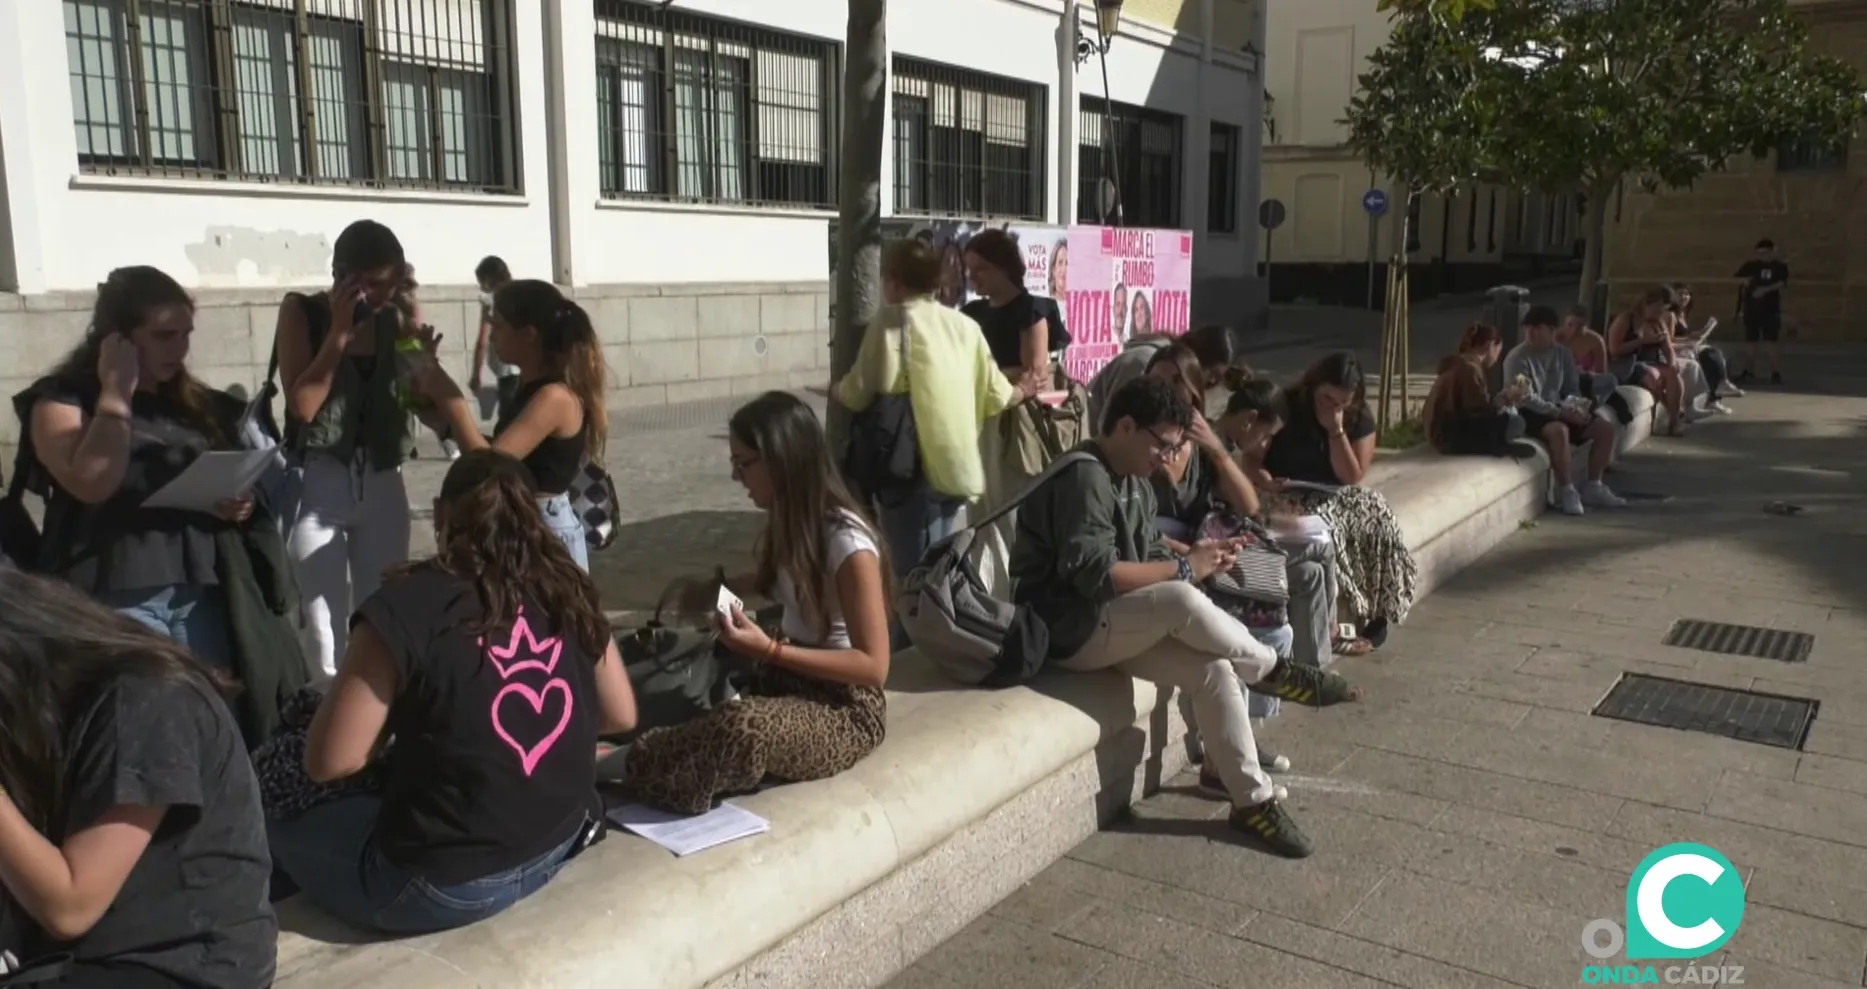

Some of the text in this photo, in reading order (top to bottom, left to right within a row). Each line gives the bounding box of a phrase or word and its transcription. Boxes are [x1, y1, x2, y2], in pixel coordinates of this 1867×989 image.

[1028, 244, 1046, 256] VOTA
[1112, 227, 1154, 259] MARCA EL
[1028, 255, 1046, 270] MÁS
[1122, 260, 1154, 288] RUMBO
[1066, 290, 1112, 344] VOTA
[1153, 290, 1188, 334] VOTA
